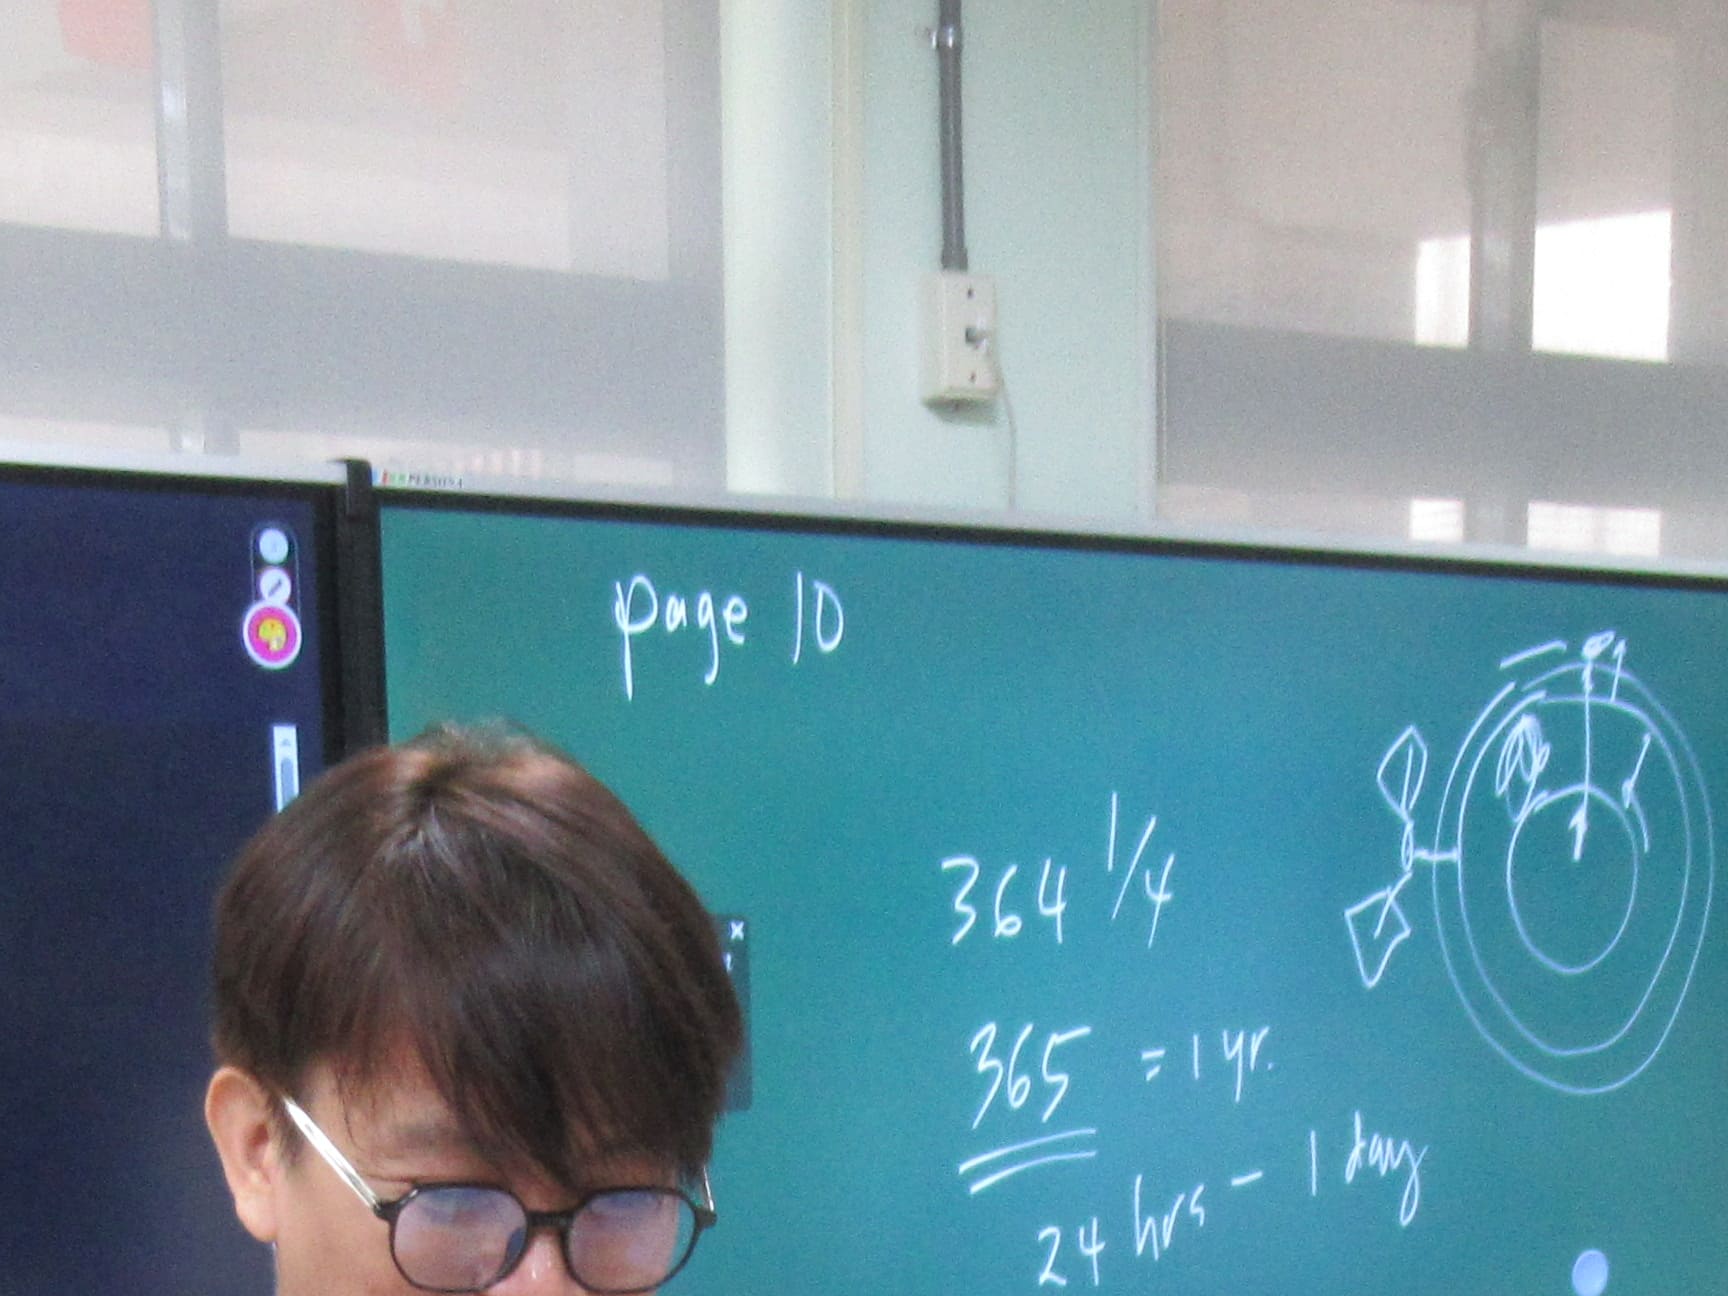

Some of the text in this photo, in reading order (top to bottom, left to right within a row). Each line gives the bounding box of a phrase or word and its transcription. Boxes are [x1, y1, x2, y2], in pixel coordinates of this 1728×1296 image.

[614, 571, 844, 701] page 10
[941, 854, 1067, 945] 364
[971, 1022, 1091, 1129] 365
[1038, 1217, 1105, 1286] 24
[1134, 1174, 1204, 1260] hrs
[1345, 1110, 1428, 1227] day
